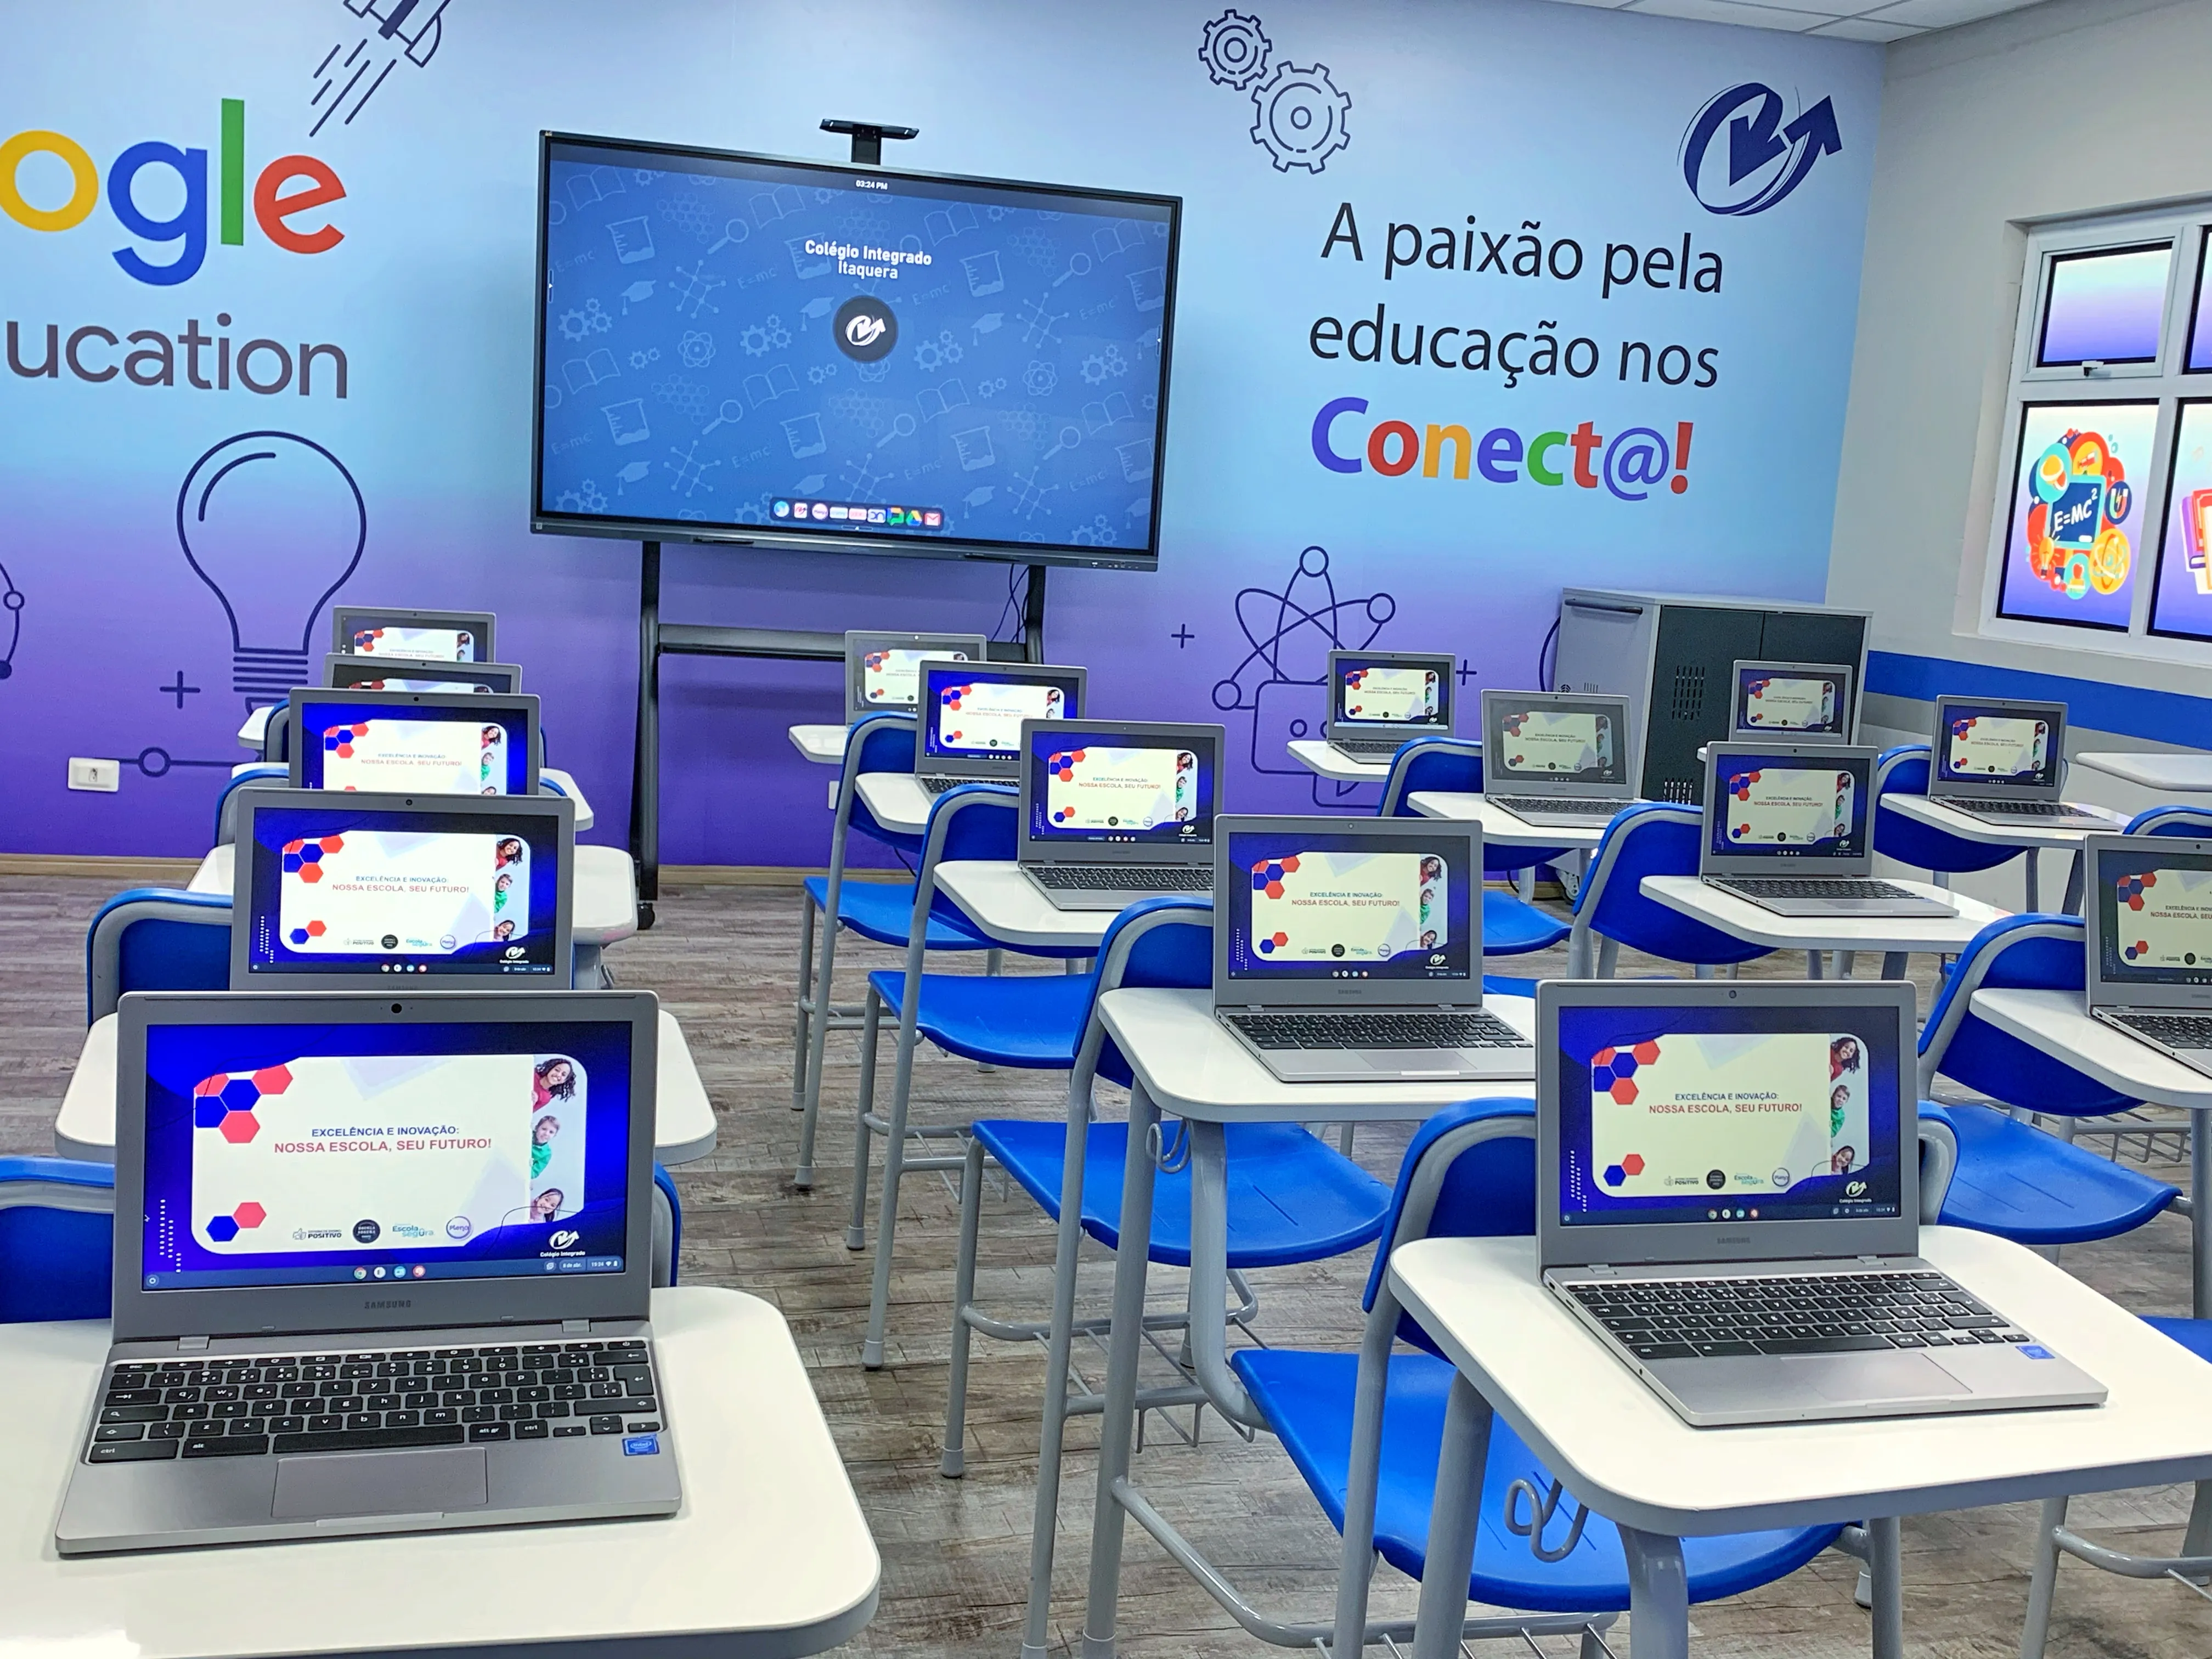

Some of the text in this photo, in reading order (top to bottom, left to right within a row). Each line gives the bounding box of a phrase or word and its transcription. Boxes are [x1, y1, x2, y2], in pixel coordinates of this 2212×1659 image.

[0, 98, 347, 286] ogle
[856, 180, 888, 190] 03:24 PM
[805, 240, 932, 265] Colégio Integrado
[1321, 202, 1723, 298] A paixão pela
[839, 261, 898, 279] Itaquera
[7, 313, 348, 399] ucation
[1310, 303, 1719, 388] educação nos
[1312, 397, 1693, 501] Conect@!
[1758, 1104, 1802, 1112] FUTURO!
[312, 1127, 383, 1137] EXCELÊNCIA
[275, 1142, 325, 1153] NOSSA
[397, 1140, 424, 1150] SEU
[430, 1138, 492, 1149] FUTURO!
[365, 1300, 411, 1309] SAMSUNG
